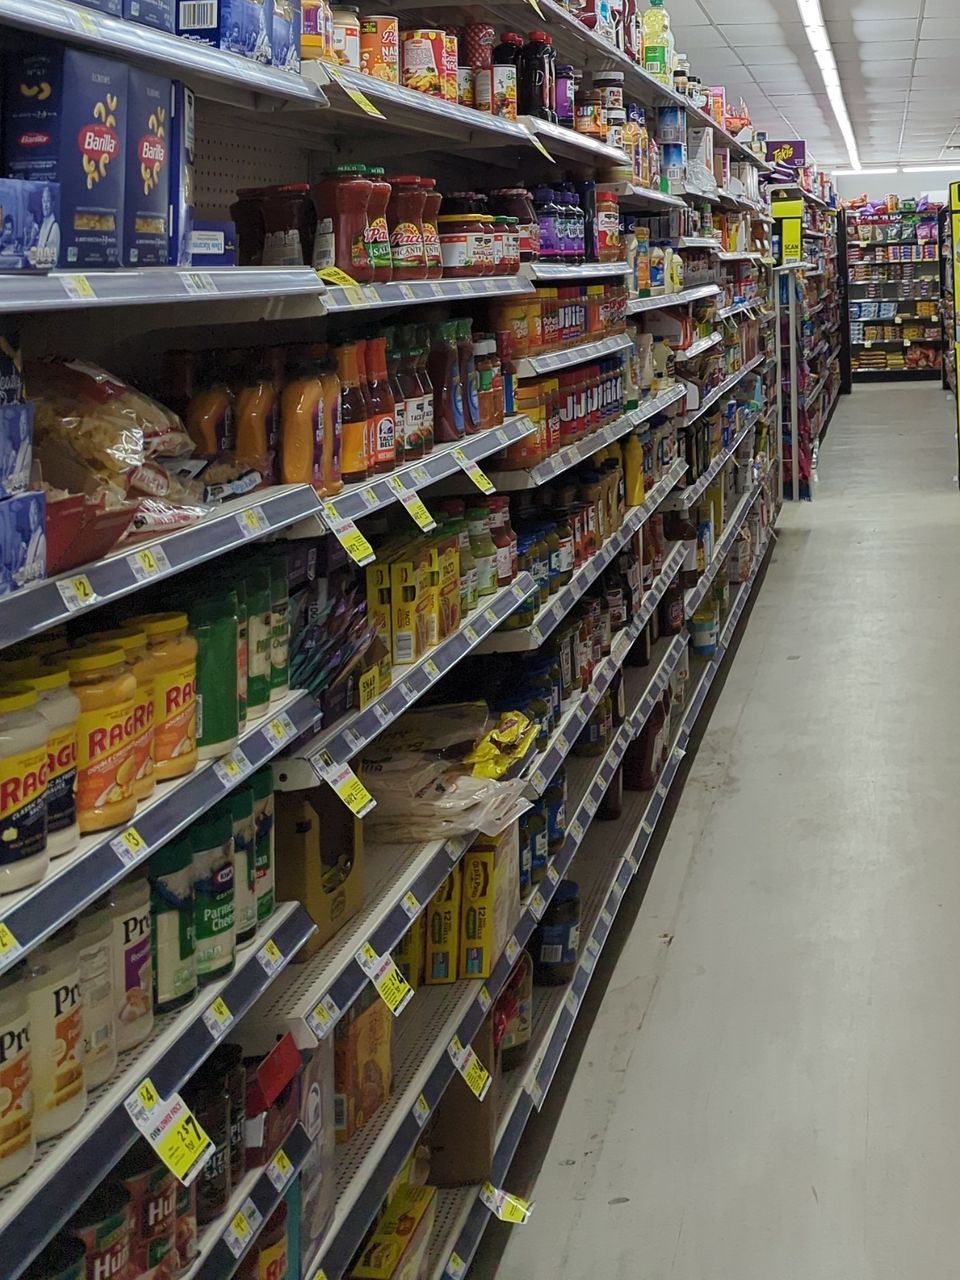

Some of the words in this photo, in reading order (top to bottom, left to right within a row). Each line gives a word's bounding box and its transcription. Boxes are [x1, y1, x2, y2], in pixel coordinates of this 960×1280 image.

[84, 131, 117, 153] Barilla
[142, 141, 165, 161] Barilla
[773, 146, 795, 161] Takis
[373, 245, 390, 256] SAL
[378, 435, 395, 443] TACO
[165, 677, 196, 715] RAG
[88, 712, 135, 759] RAG
[203, 903, 235, 921] Parme
[212, 914, 234, 932] Chee
